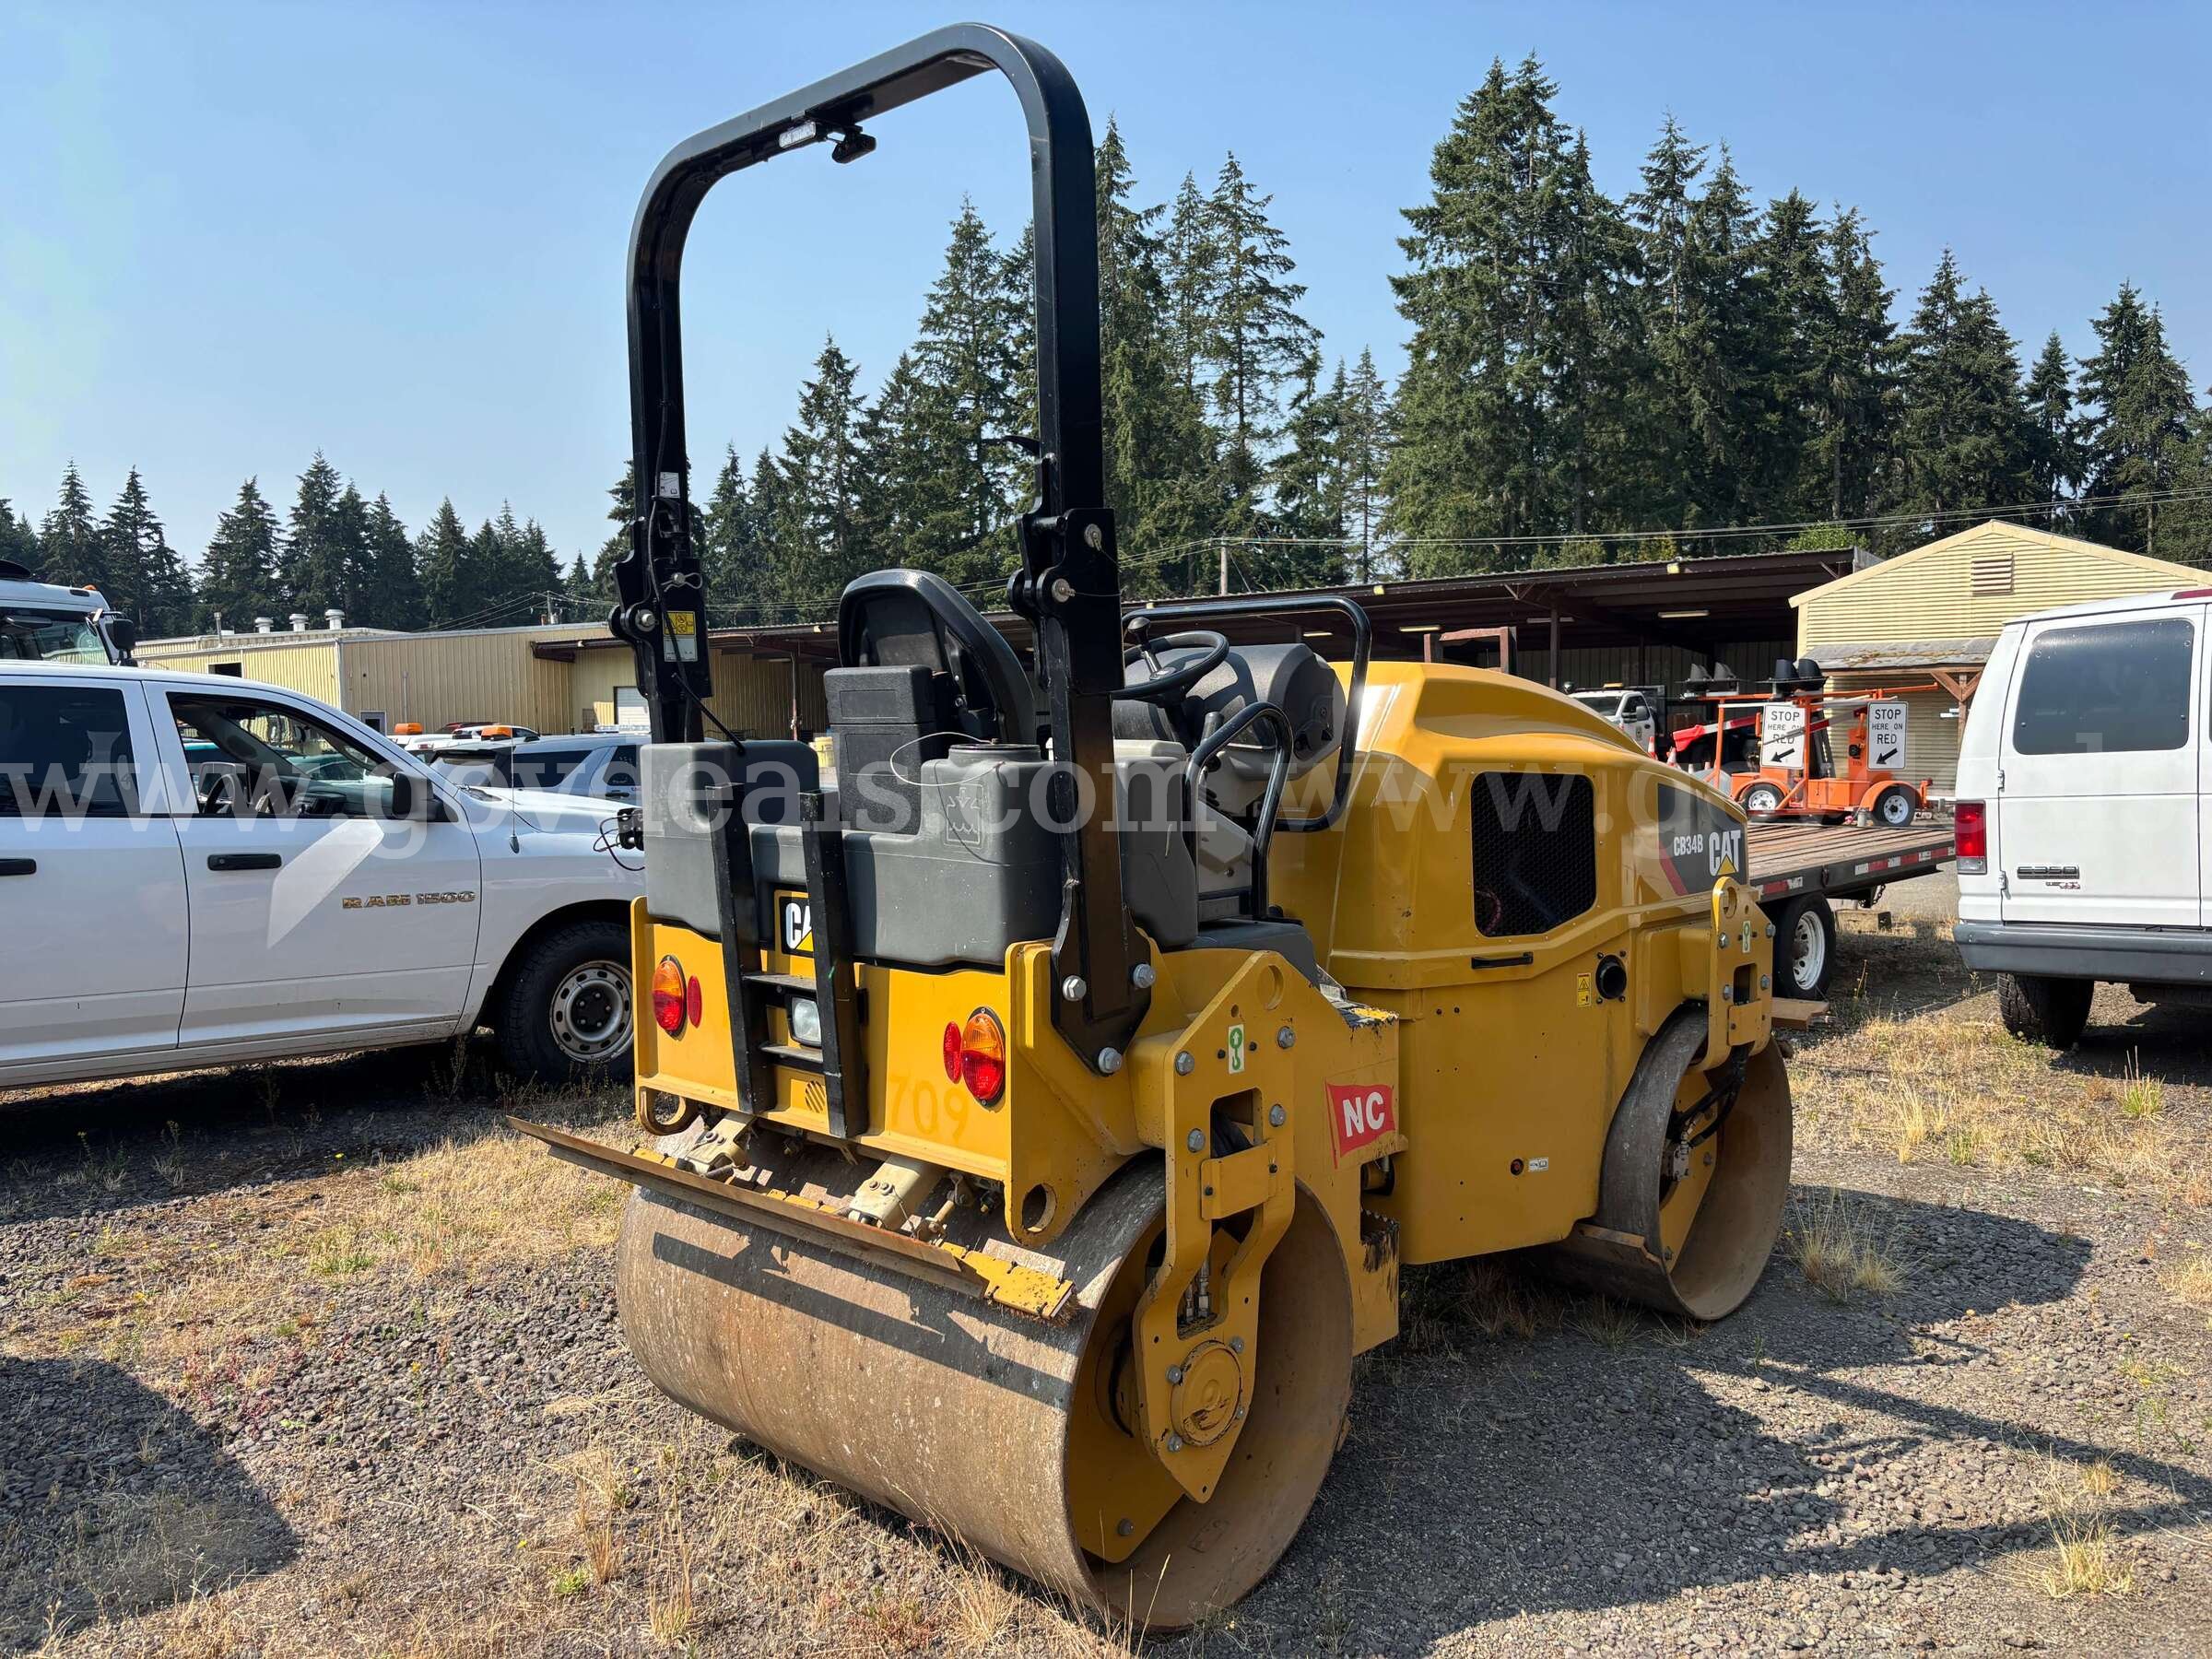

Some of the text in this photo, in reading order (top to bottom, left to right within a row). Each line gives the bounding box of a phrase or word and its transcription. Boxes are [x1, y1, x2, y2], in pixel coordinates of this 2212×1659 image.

[1771, 711, 1800, 722] STOP
[1875, 709, 1901, 720] STOP
[1877, 734, 1898, 744] RED
[1673, 830, 1741, 877] CB34B CAT
[342, 890, 476, 909] RAM 1500
[785, 902, 812, 949] CA
[888, 1075, 969, 1146] 709
[1342, 1091, 1385, 1137] NC
